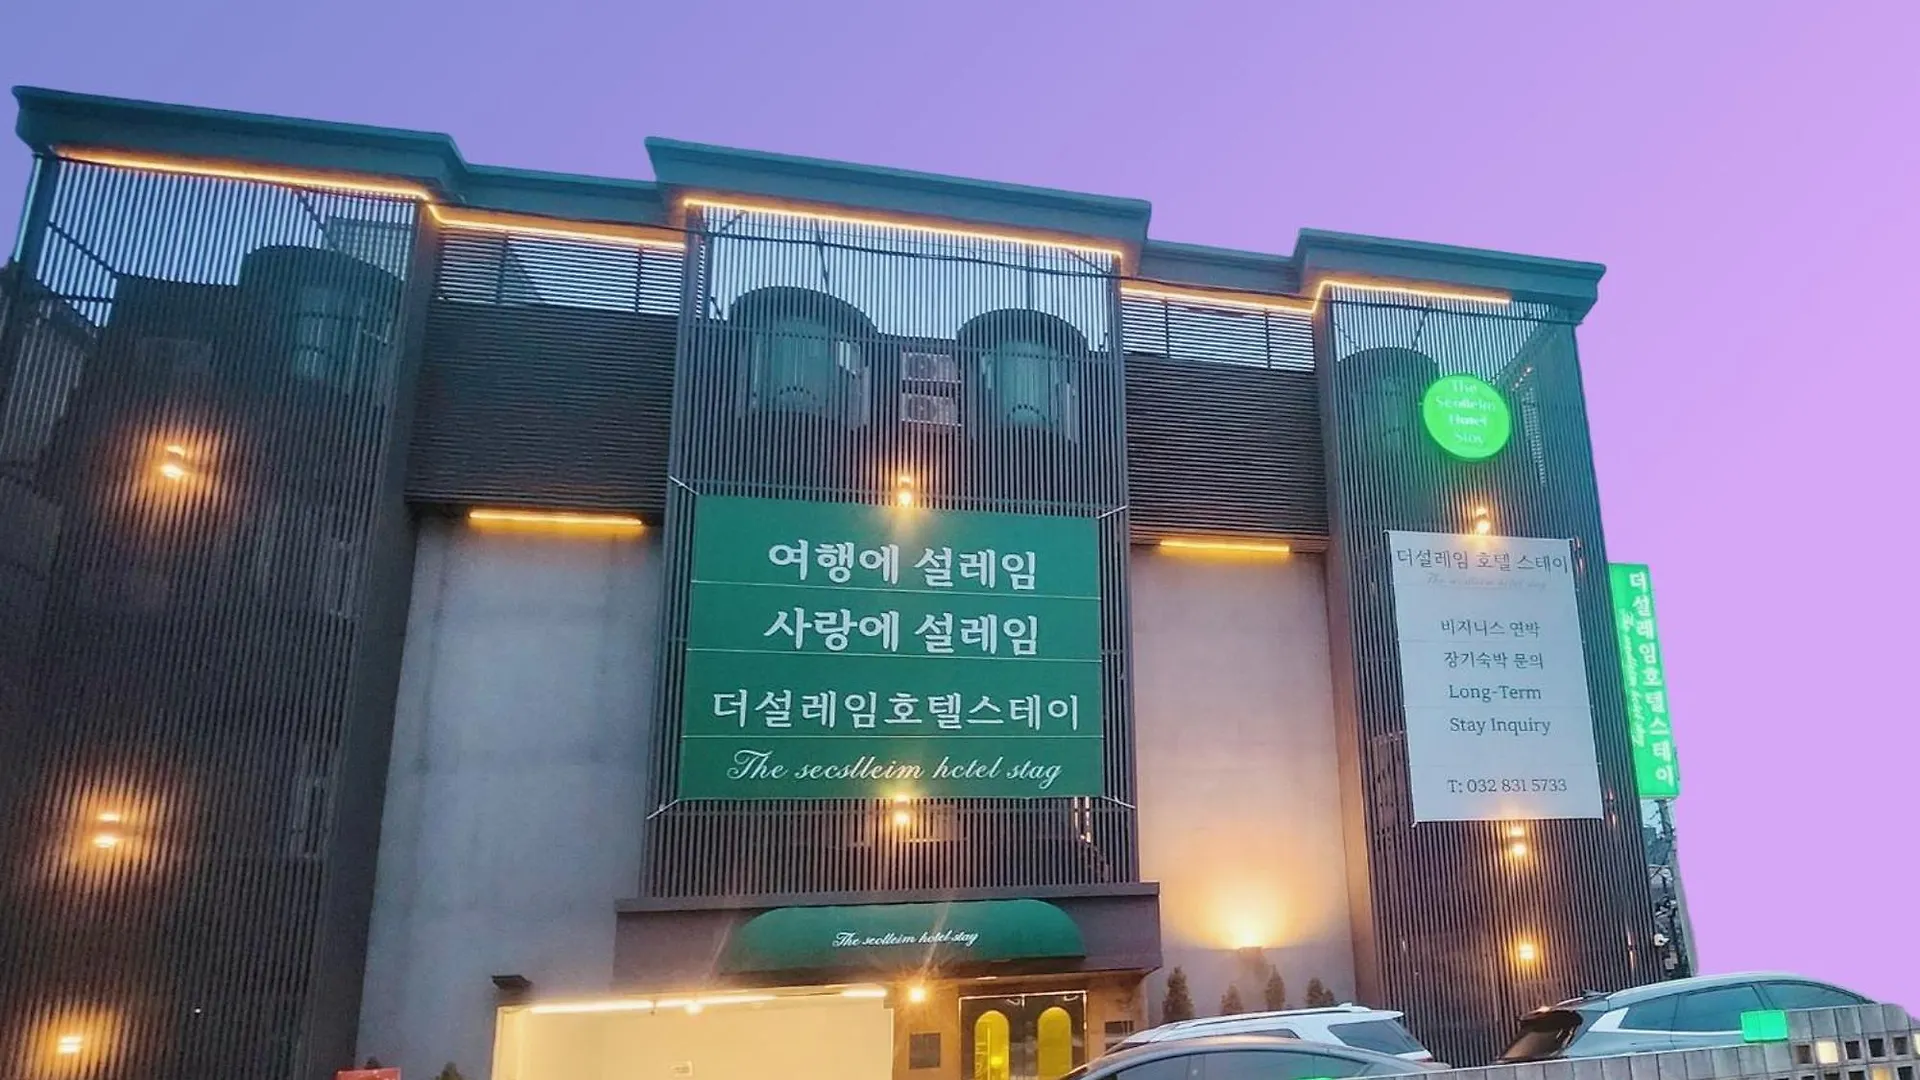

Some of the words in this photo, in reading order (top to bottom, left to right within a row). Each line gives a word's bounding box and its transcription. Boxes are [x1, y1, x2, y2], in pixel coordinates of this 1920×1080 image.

[768, 539, 899, 584] 여행에
[913, 546, 1037, 590] 설레임
[1397, 548, 1469, 570] 더설레임
[1476, 551, 1511, 572] 호텔
[1517, 554, 1569, 574] 스테이
[763, 607, 899, 652] 사랑에
[914, 612, 1038, 656] 설레임
[1509, 621, 1541, 639] 연박
[1443, 650, 1509, 669] 장기숙박
[1513, 652, 1544, 670] 문의
[1449, 685, 1542, 702] Long-Term
[712, 689, 1079, 730] 더설레임호텔스테이
[1450, 718, 1486, 736] Stay
[1491, 718, 1551, 736] Inquiry
[726, 749, 788, 780] The
[1466, 778, 1497, 793] 032
[1501, 778, 1527, 793] 831
[1531, 778, 1568, 793] 5733
[832, 931, 862, 947] The
